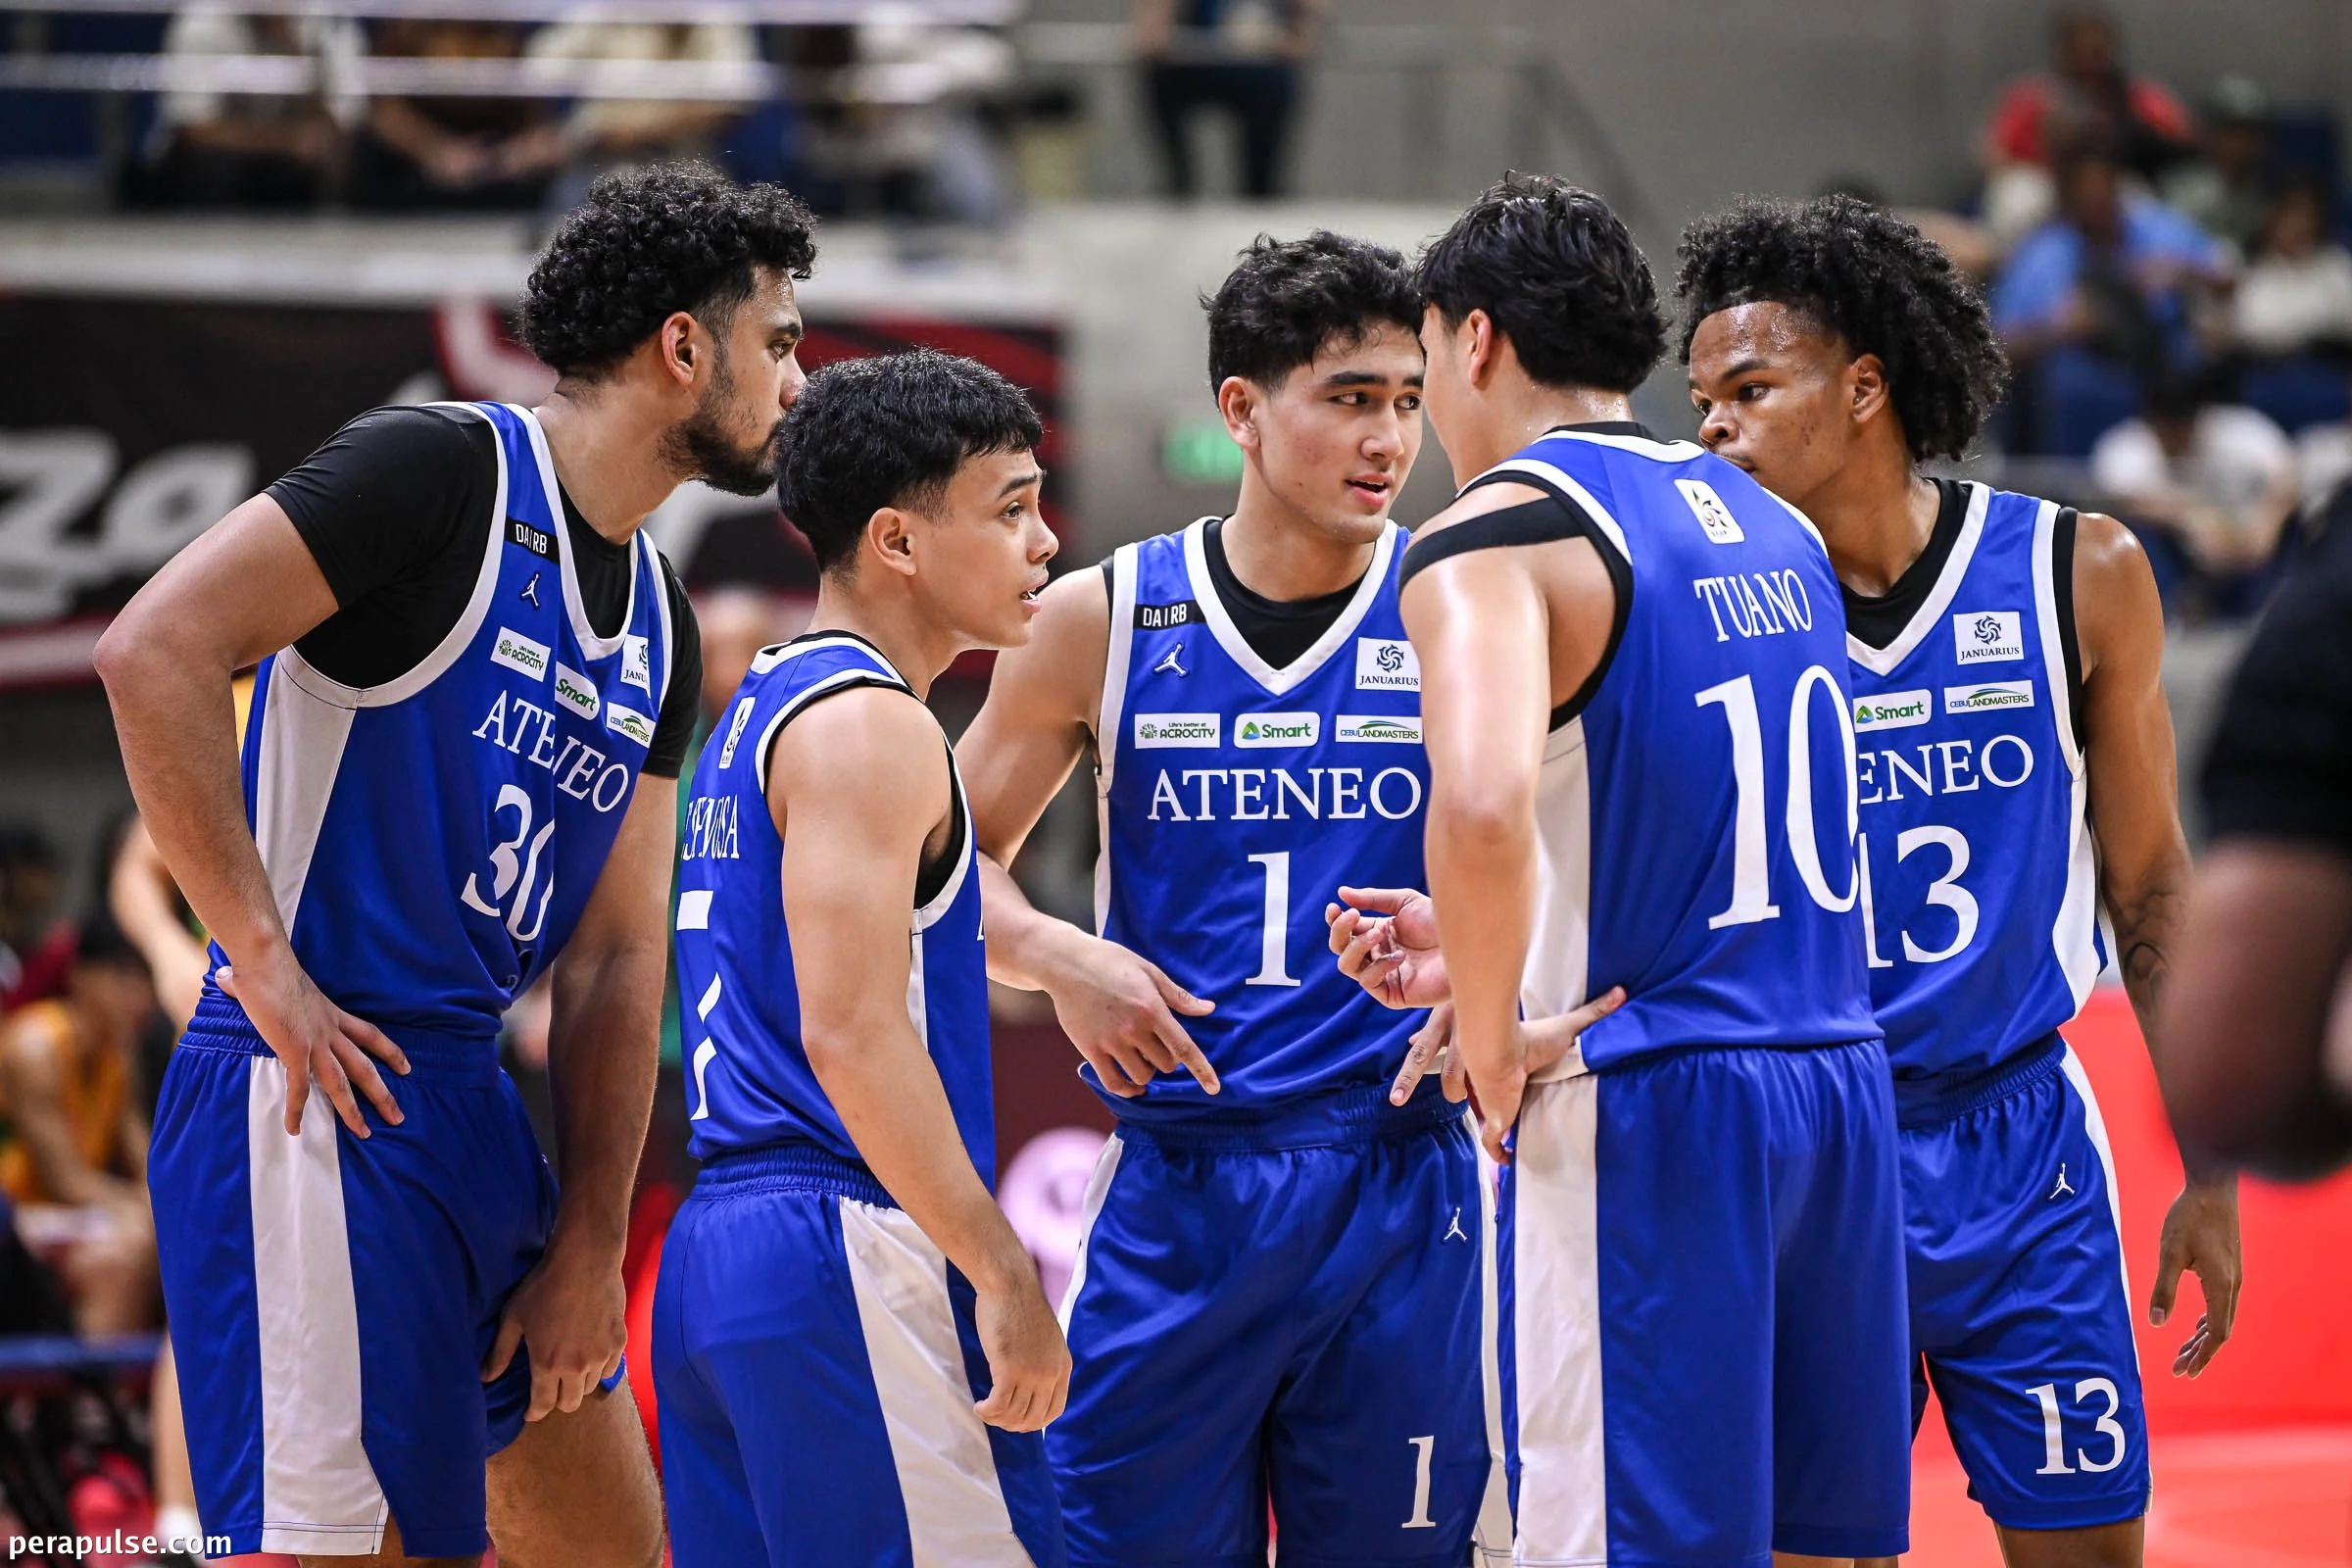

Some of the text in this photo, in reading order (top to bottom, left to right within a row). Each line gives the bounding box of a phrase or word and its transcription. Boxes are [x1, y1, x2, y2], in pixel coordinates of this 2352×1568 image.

[1693, 567, 1813, 644] TUANO
[512, 649, 545, 671] ACROCITY
[1960, 647, 2020, 662] JANUARIUS
[556, 678, 597, 711] Smart
[1359, 674, 1419, 687] JANUARIUS
[1262, 722, 1311, 739] Smart
[1876, 701, 1925, 721] Smart
[1160, 729, 1215, 739] ACROCITY
[1858, 735, 2034, 805] ENEO
[1148, 767, 1421, 821] ATENEO
[1694, 664, 1860, 931] 10
[1246, 851, 1301, 987] 1
[2025, 1377, 2126, 1475] 13
[1401, 1435, 1437, 1529] 1
